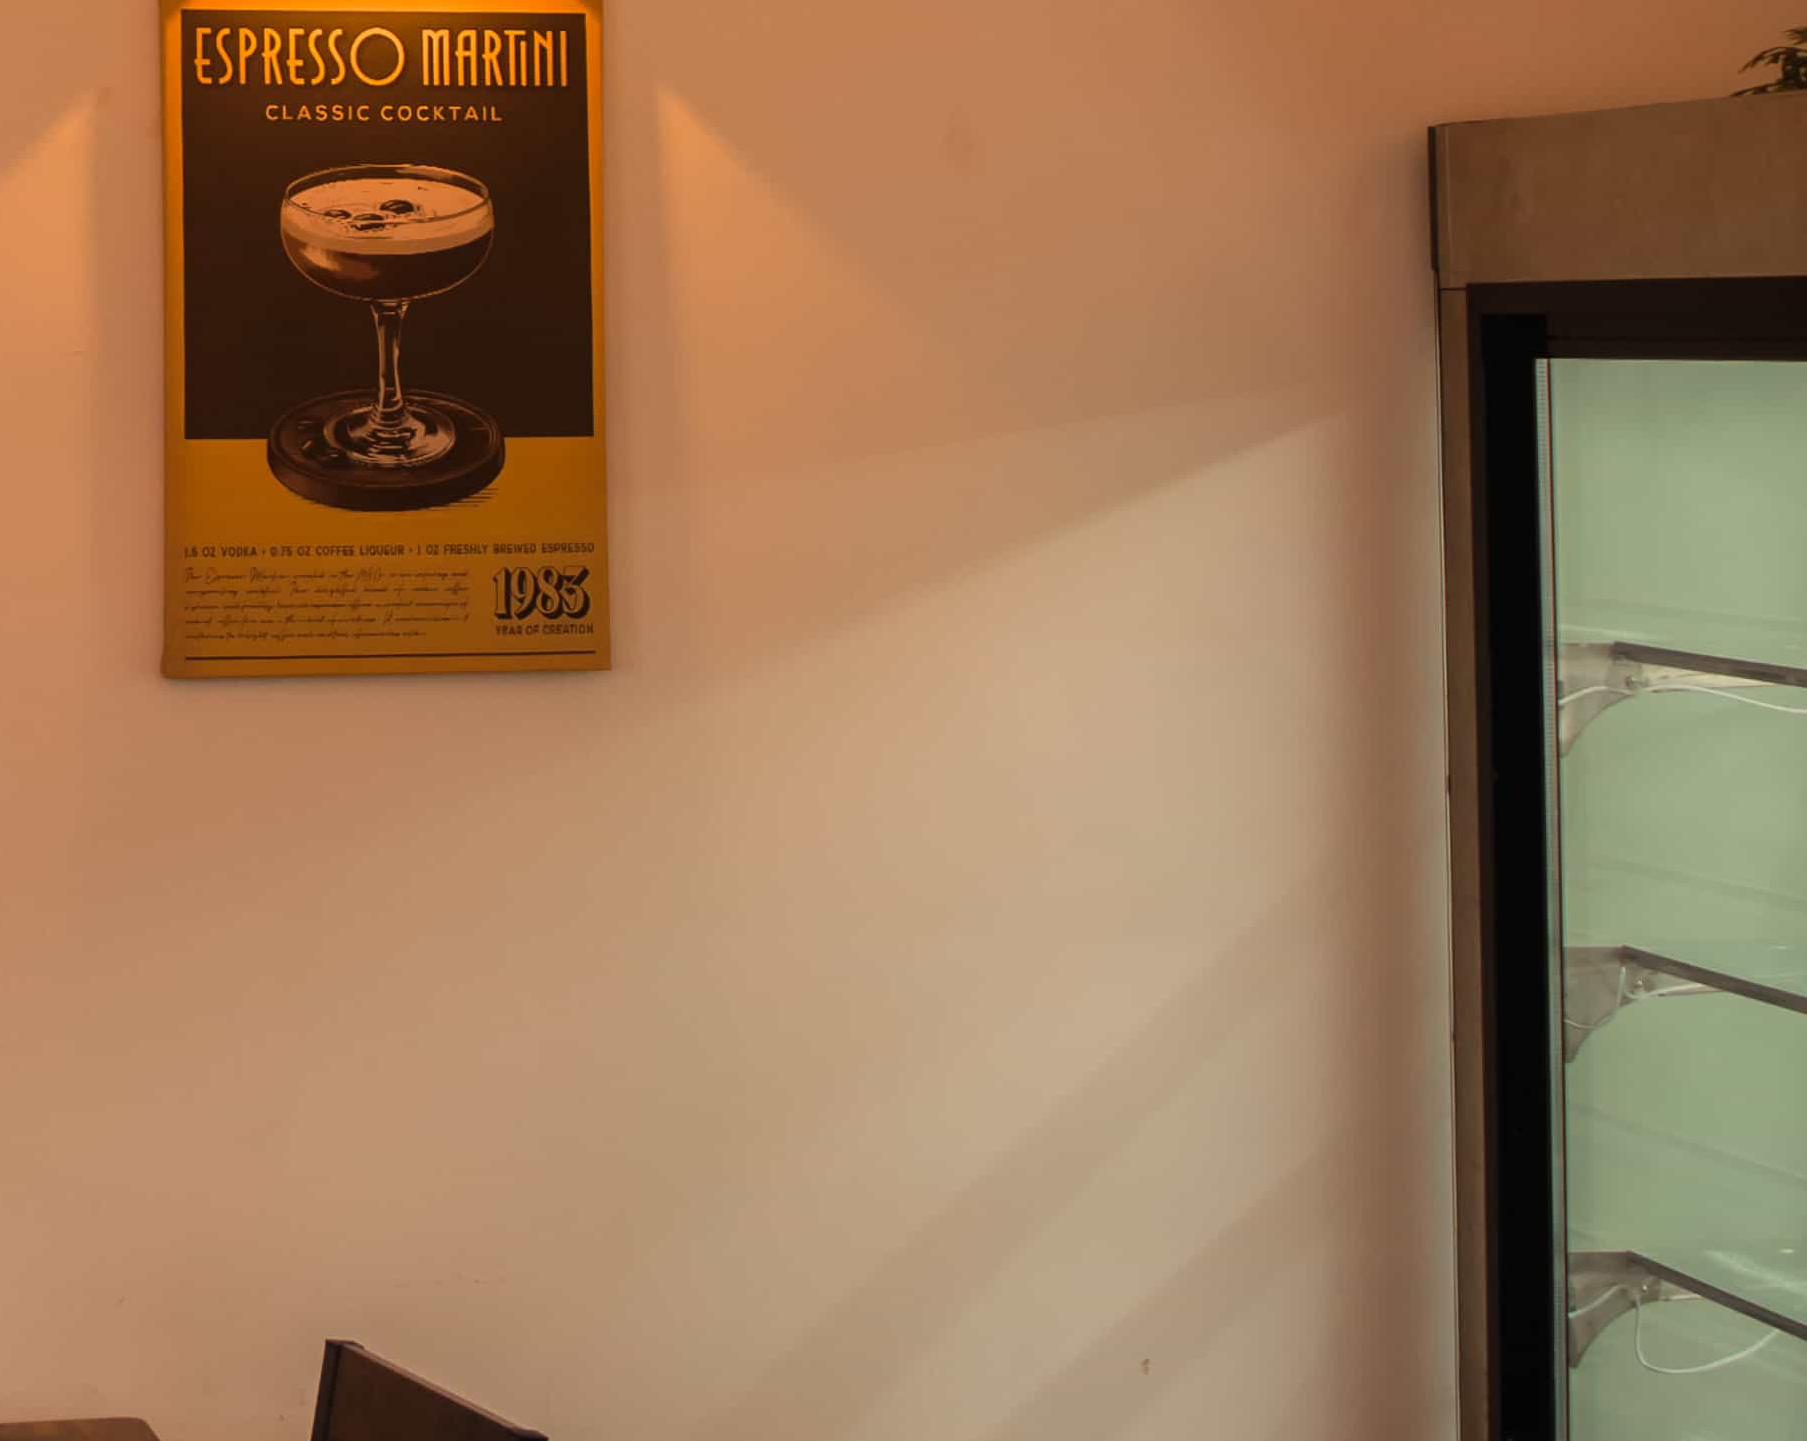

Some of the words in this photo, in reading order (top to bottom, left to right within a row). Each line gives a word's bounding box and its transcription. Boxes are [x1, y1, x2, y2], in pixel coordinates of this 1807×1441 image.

[194, 27, 405, 87] ESPRESSO
[421, 29, 568, 88] MARTINI
[265, 104, 371, 122] CLASSIC
[380, 104, 504, 122] COCKTAIL
[201, 545, 216, 558] OZ
[220, 545, 259, 558] VODKA
[297, 544, 311, 557] OZ
[315, 544, 355, 557] COFFEE
[359, 543, 405, 557] LIQUEUR
[425, 543, 439, 556] OZ
[443, 543, 489, 556] FRESHLY
[492, 542, 537, 555] BREWED
[541, 542, 594, 554] ESPRESSO
[495, 625, 523, 636] YEAR
[525, 624, 540, 636] OF
[542, 623, 594, 635] CREATION
